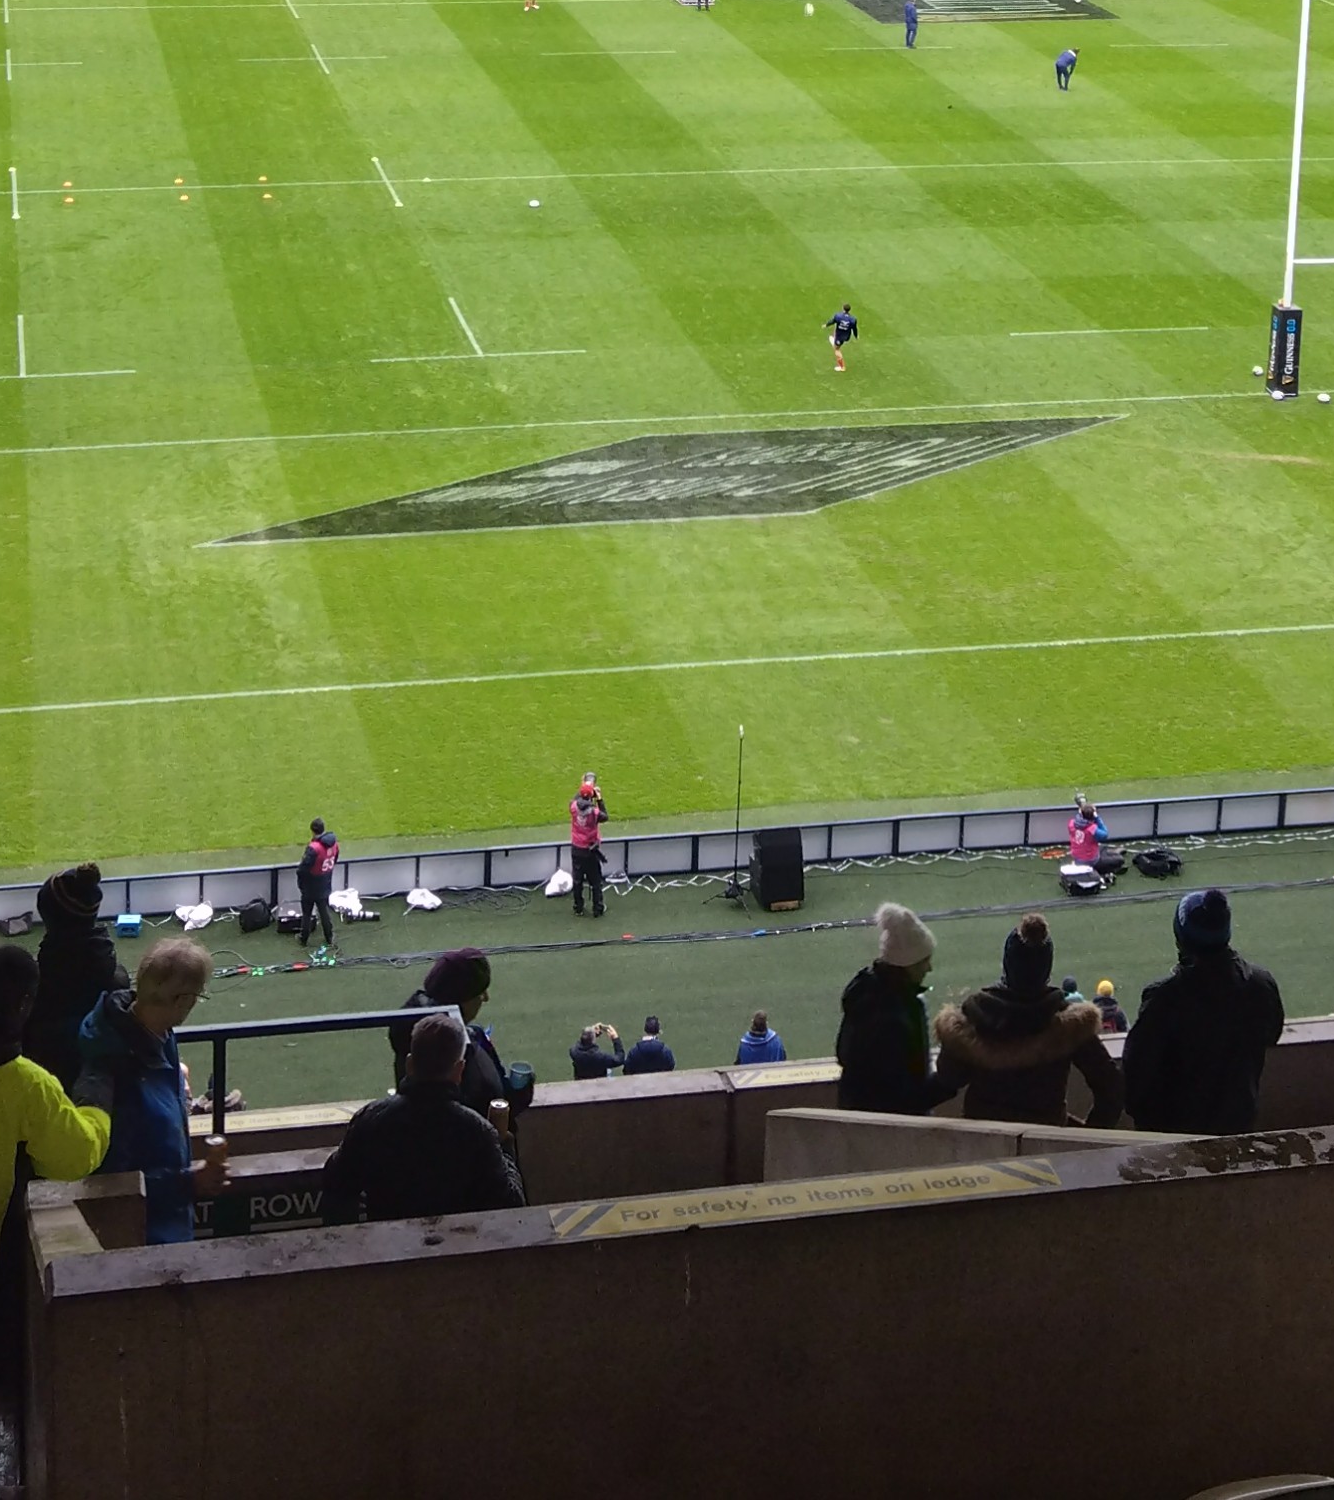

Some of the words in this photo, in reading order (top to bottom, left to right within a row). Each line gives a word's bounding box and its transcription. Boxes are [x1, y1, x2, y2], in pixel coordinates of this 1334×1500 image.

[1283, 333, 1295, 374] GUINNESS
[250, 1191, 324, 1220] ROW
[621, 1208, 660, 1222] For
[673, 1198, 757, 1217] safety,
[768, 1195, 797, 1207] no
[807, 1184, 874, 1203] items
[885, 1181, 914, 1195] on
[923, 1174, 991, 1190] ledge
